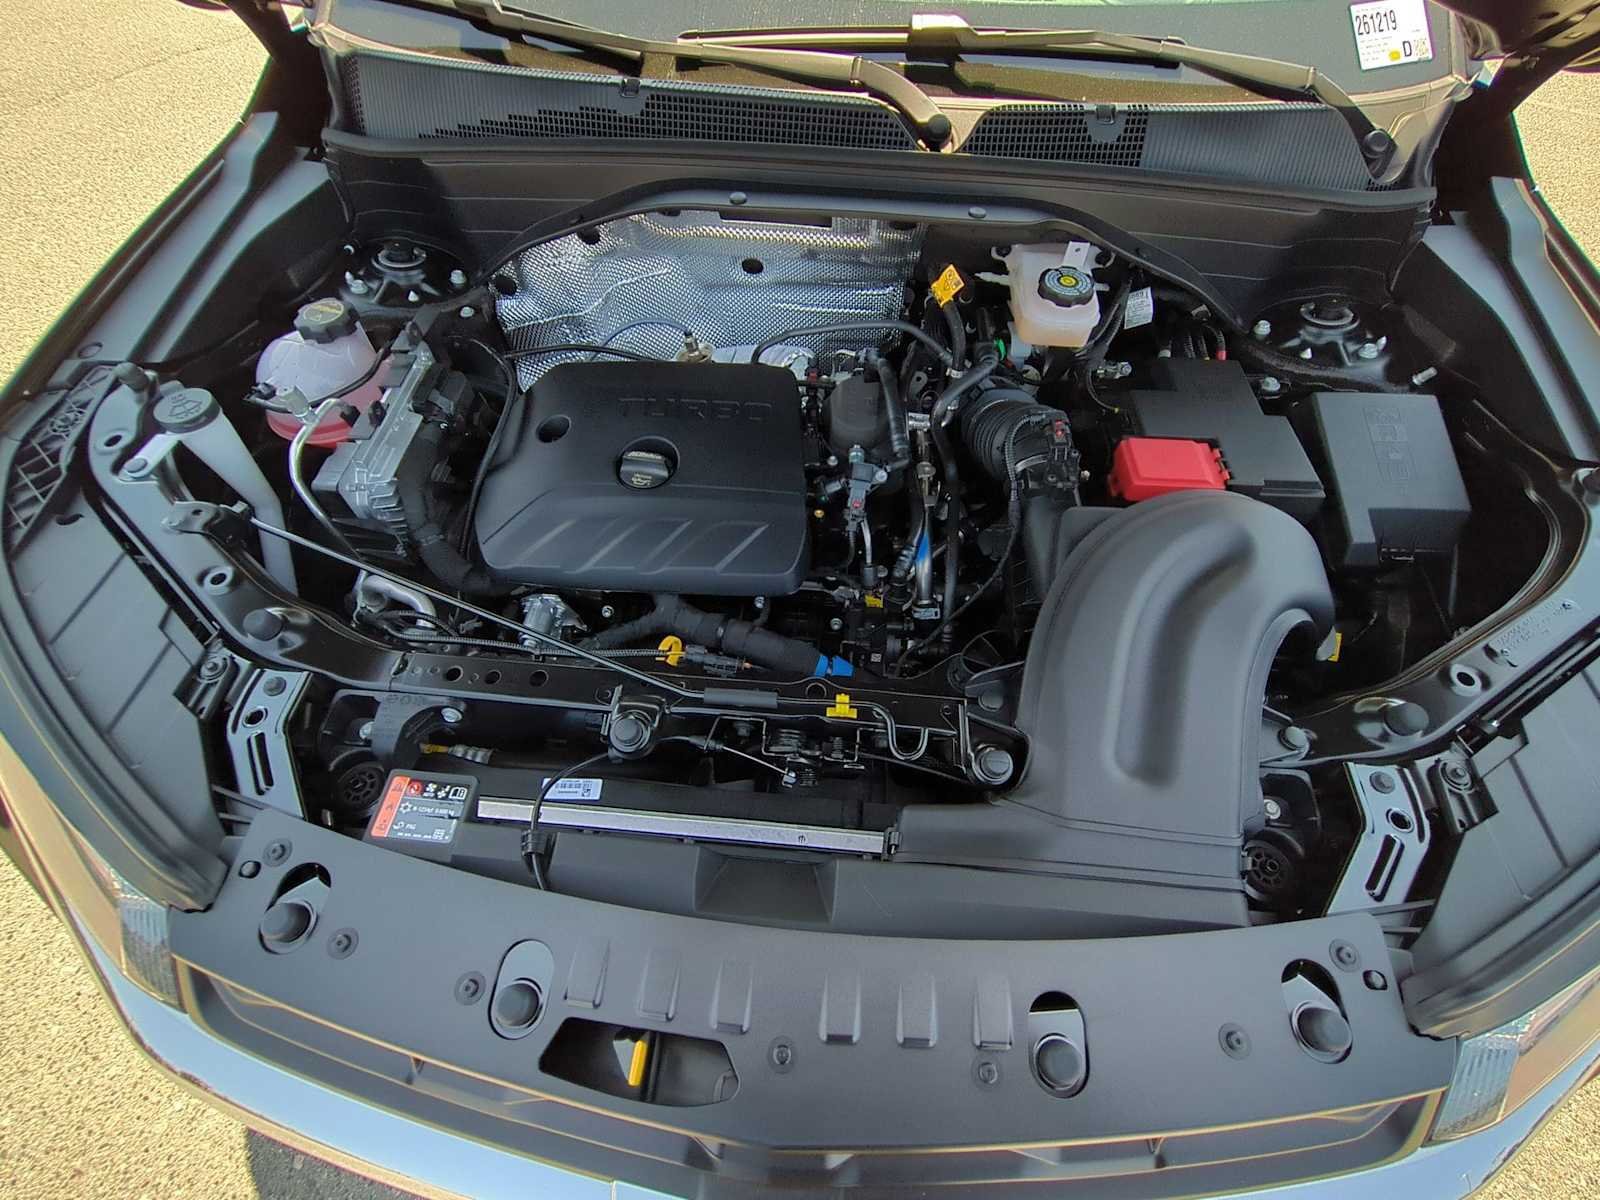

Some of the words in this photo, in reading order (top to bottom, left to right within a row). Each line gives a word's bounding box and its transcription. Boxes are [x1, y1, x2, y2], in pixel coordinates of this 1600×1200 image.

[1355, 10, 1397, 35] 261219
[1402, 40, 1413, 57] D
[617, 397, 773, 421] TURBO
